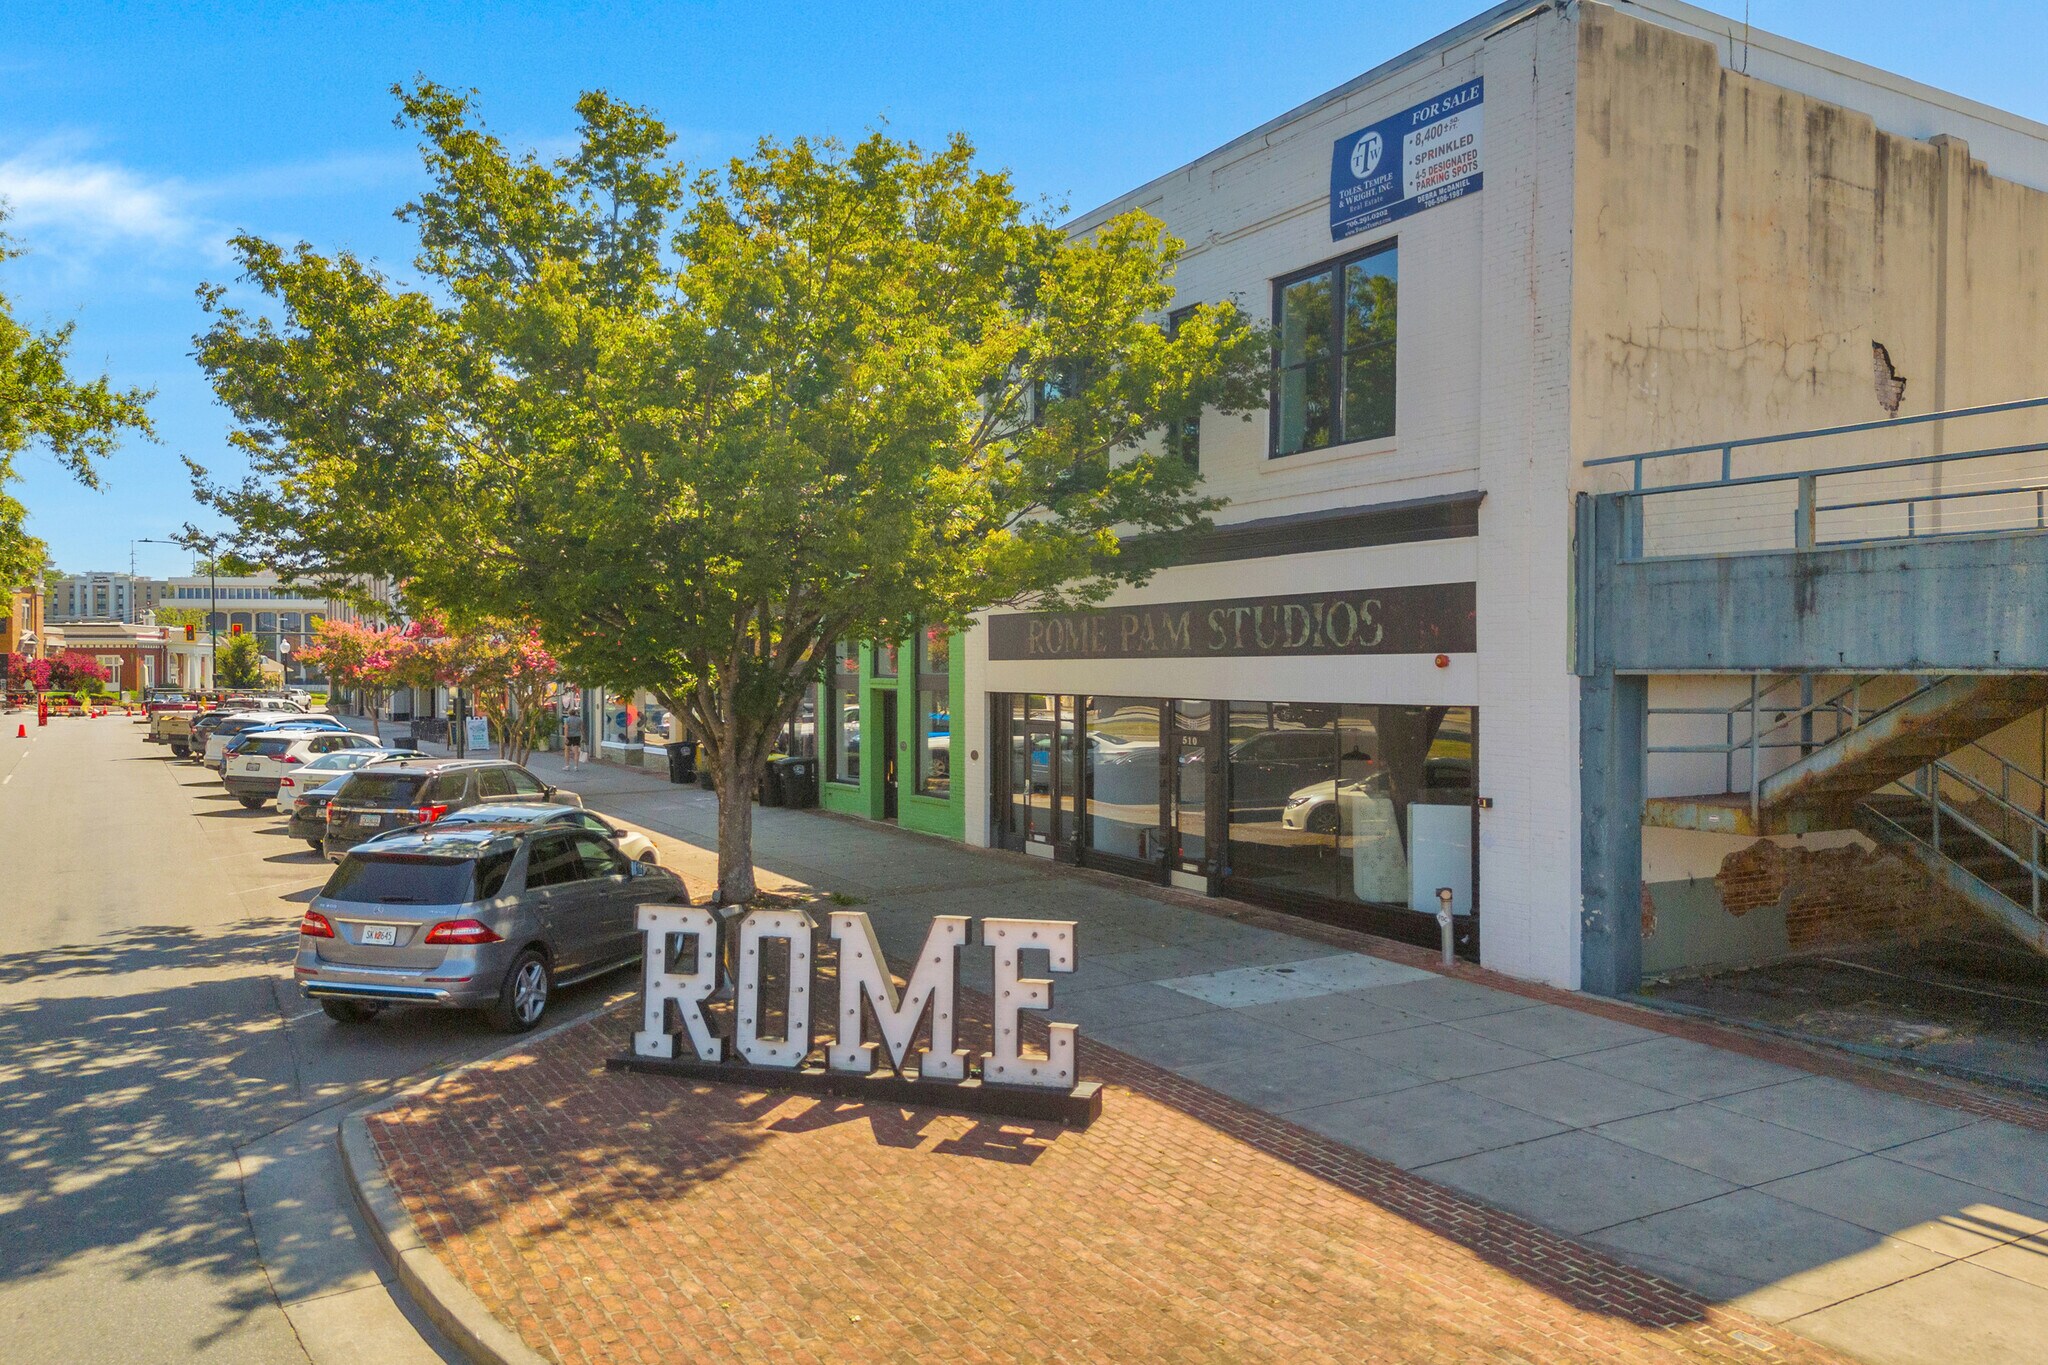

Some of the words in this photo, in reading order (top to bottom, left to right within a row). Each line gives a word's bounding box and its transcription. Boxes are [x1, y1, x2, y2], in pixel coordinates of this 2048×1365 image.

[1412, 102, 1440, 126] FOR
[1442, 85, 1480, 112] SALE
[1415, 133, 1474, 166] SPRINKLED
[1415, 168, 1427, 181] 4-5
[1428, 149, 1478, 177] DESIGNATED
[1364, 172, 1394, 190] TEMPLE
[1416, 170, 1450, 192] PARKING
[1451, 160, 1479, 178] SPOTS
[1417, 191, 1438, 204] DEBRA
[1438, 178, 1471, 195] McDANIEL
[1338, 200, 1345, 209] &
[1345, 187, 1378, 206] WRIGHT,
[1378, 181, 1394, 194] INC.
[1349, 202, 1364, 213] Real
[1364, 196, 1384, 207] Estate
[1027, 615, 1107, 654] ROME
[1120, 612, 1193, 652] PAM
[1207, 599, 1384, 651] STUDIOS
[1182, 735, 1198, 745] 510
[633, 903, 1079, 1090] ROME
